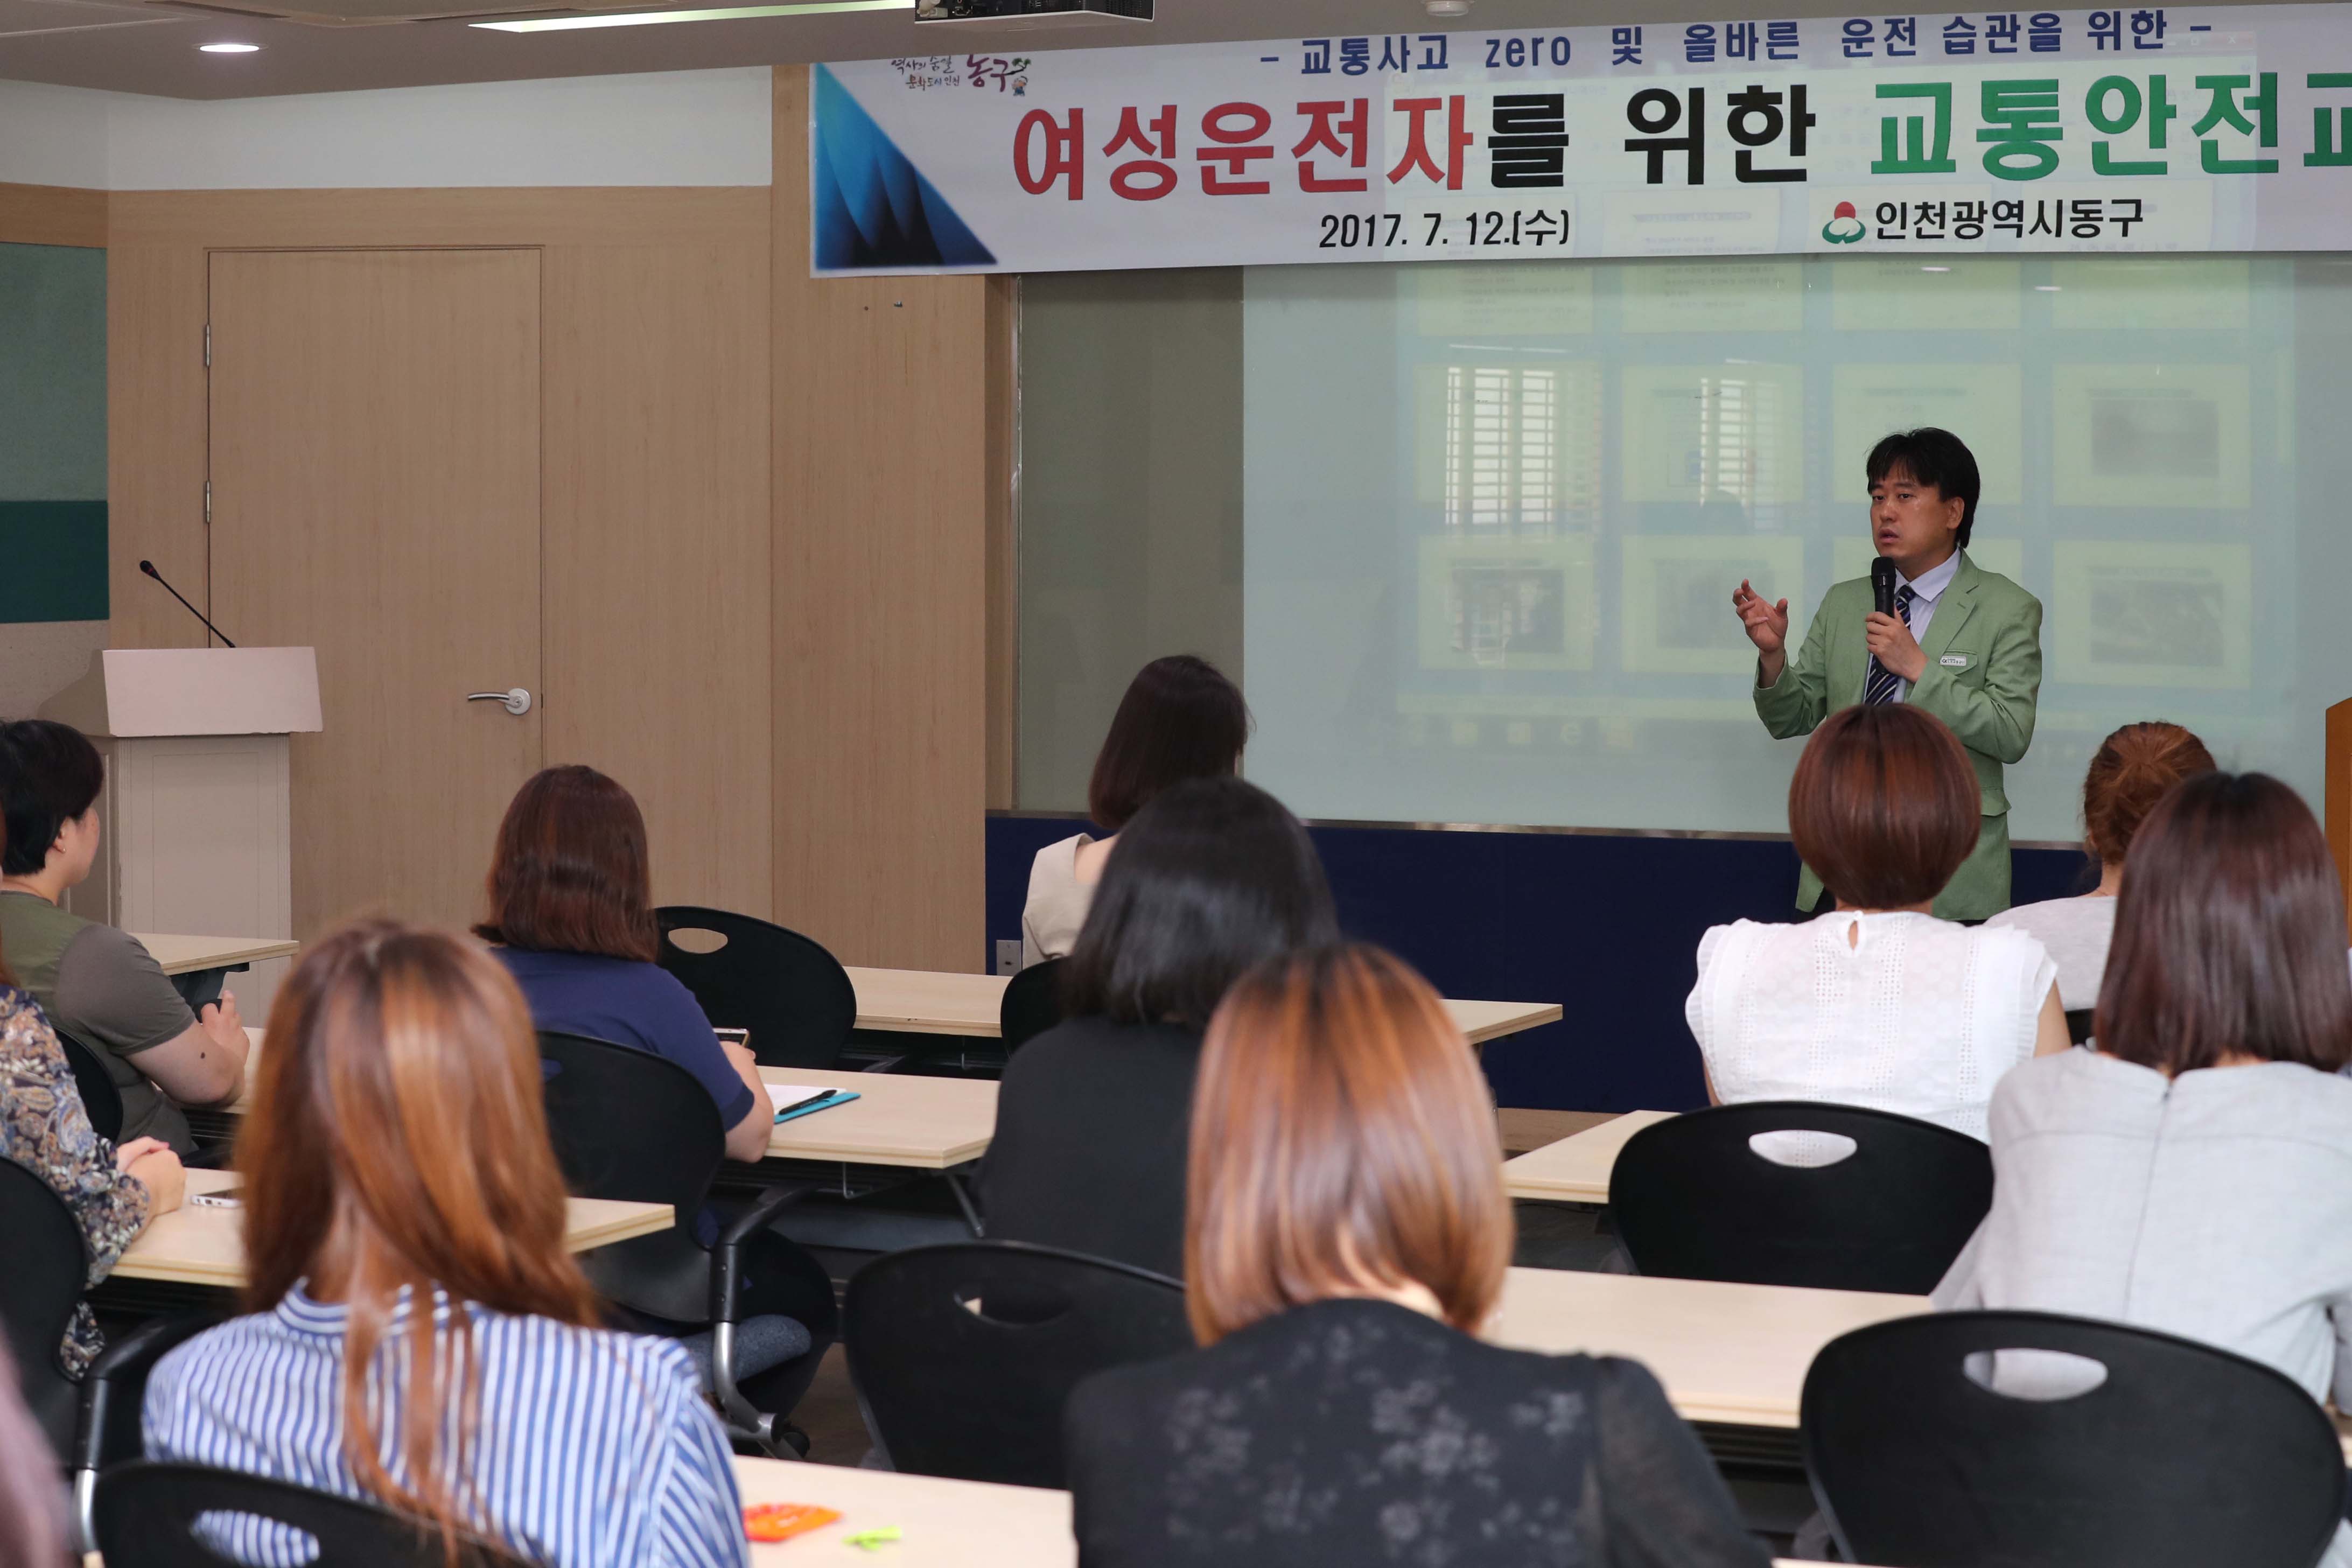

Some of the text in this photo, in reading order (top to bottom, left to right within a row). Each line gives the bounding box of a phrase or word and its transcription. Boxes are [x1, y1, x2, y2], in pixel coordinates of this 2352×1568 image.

[1301, 34, 1448, 76] 교통사고
[1485, 36, 1571, 68] zero
[1612, 26, 1642, 65] 및
[1684, 22, 1799, 62] 올바른
[1842, 17, 1916, 58] 운전
[1943, 13, 2062, 54] 습관을
[2087, 10, 2167, 50] 위한
[1013, 94, 1569, 201] 여성운전자를
[1625, 84, 1816, 185] 위한
[1319, 214, 1407, 247] 2017.
[1424, 213, 1448, 246] 7.
[1876, 199, 2144, 240] 인천광역시동구
